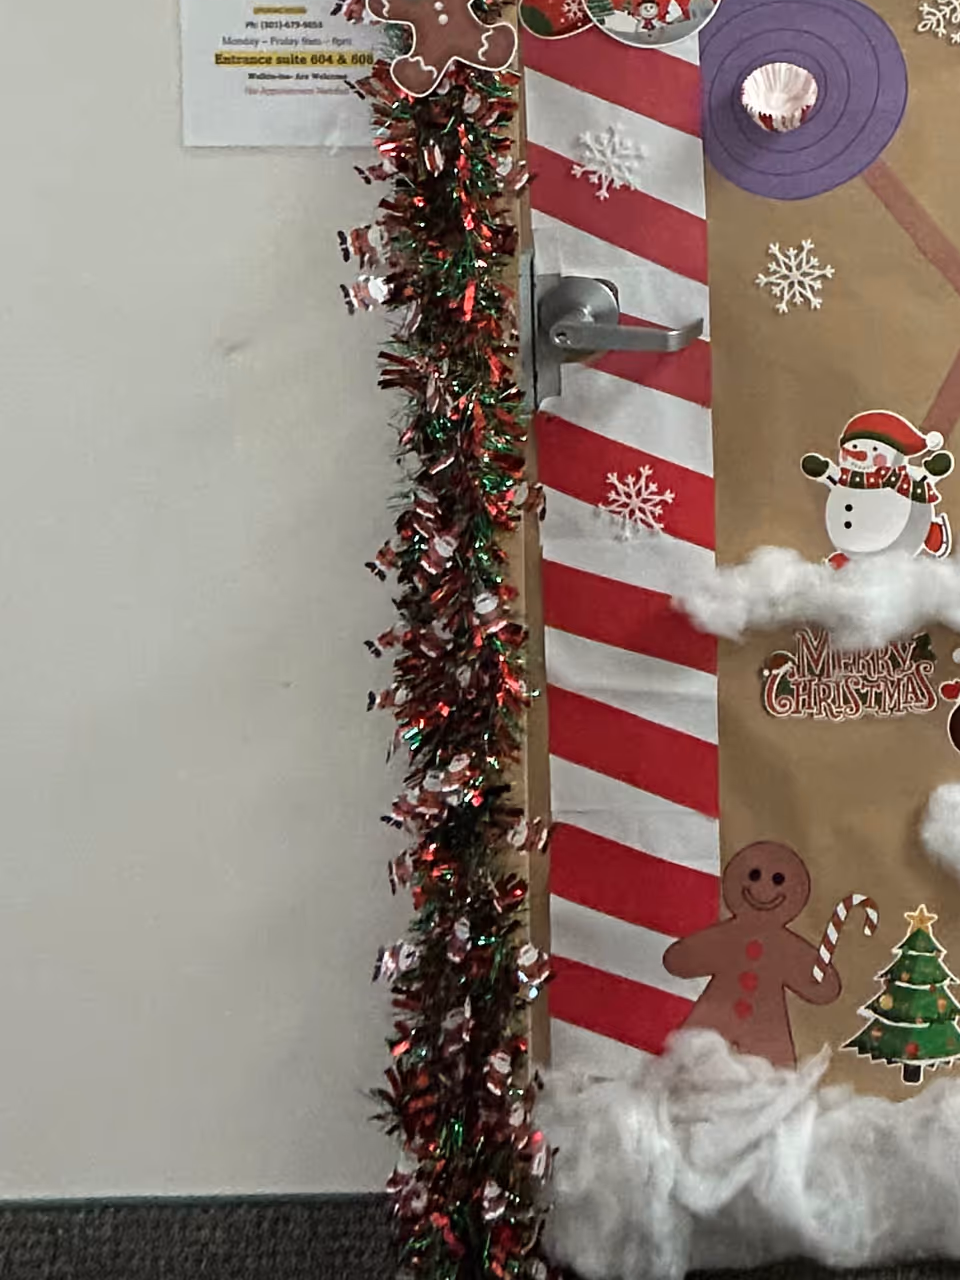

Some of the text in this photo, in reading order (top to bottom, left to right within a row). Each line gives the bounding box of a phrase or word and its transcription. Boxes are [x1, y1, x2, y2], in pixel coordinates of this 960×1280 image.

[222, 36, 260, 47] Monday
[214, 53, 374, 65] Entrance suite 604 & 608
[796, 626, 917, 680] MERRY
[764, 661, 938, 722] CHRISTMAS
